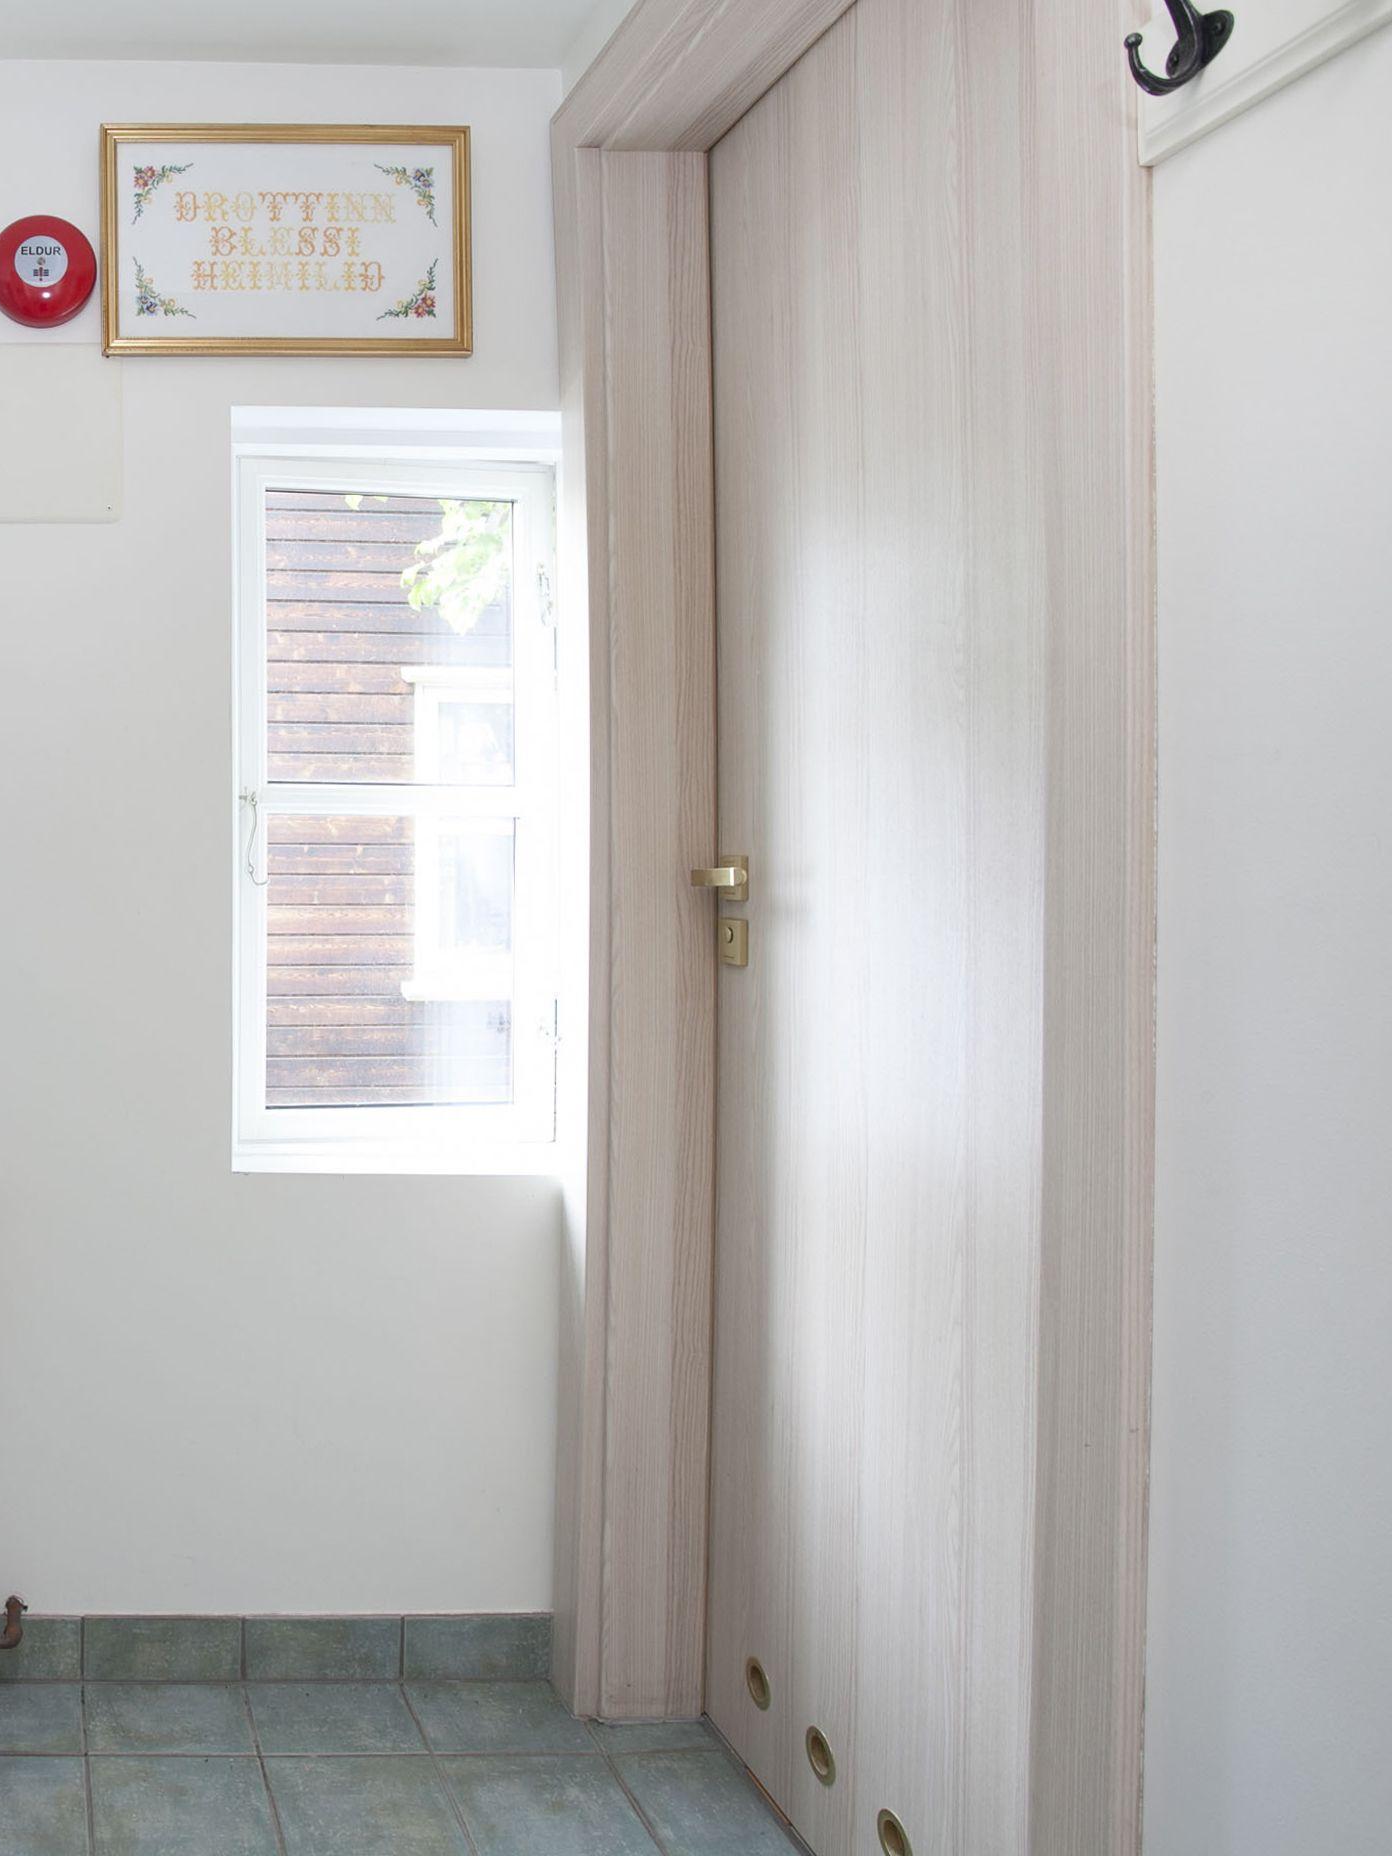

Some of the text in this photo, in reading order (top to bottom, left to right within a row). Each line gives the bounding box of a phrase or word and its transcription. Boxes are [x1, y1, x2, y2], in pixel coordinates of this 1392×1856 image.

[174, 191, 397, 224] DROTTINN
[20, 246, 61, 256] ELDUR
[209, 226, 361, 257] BLESSI
